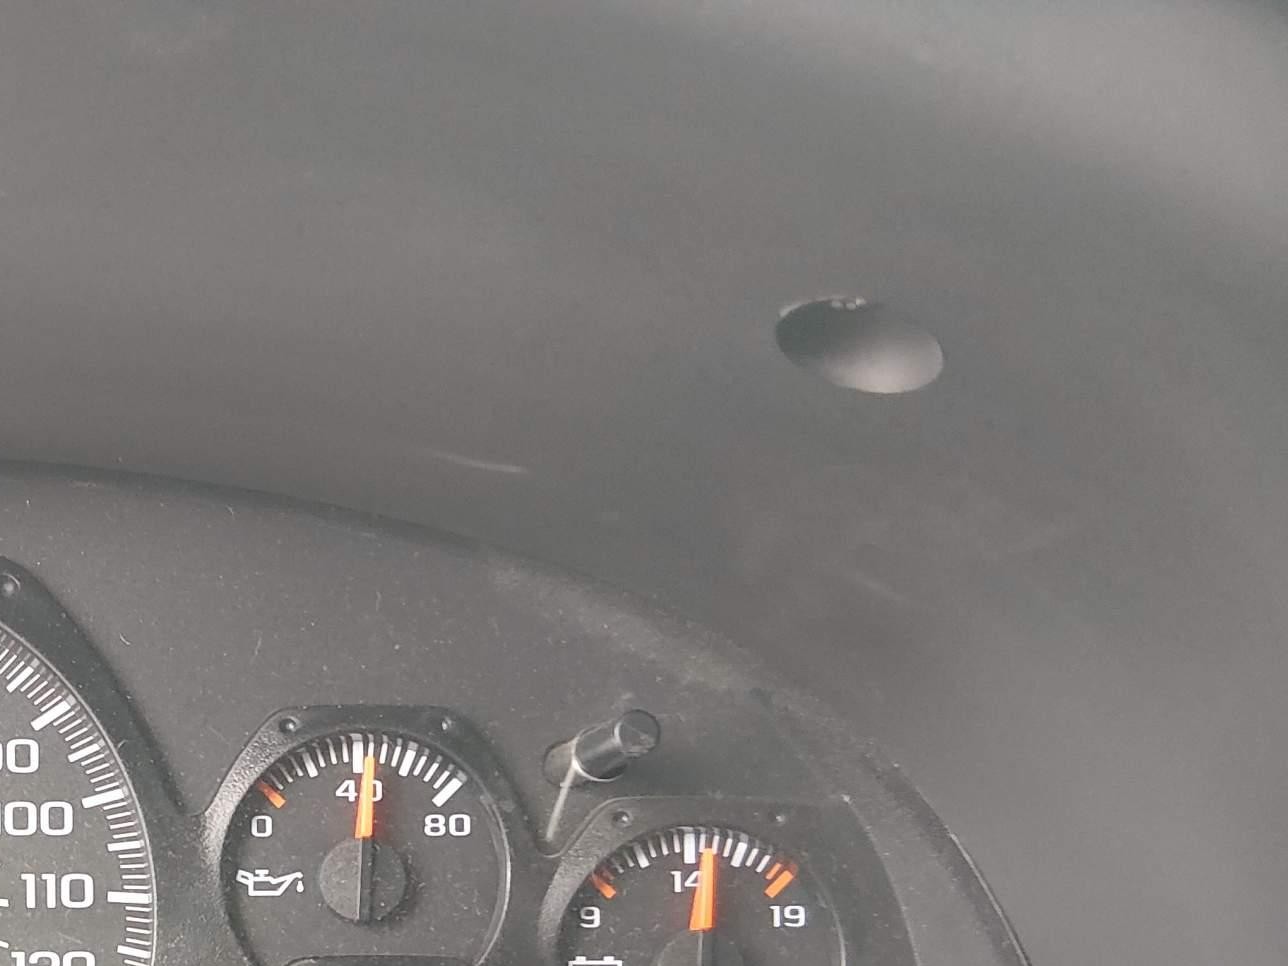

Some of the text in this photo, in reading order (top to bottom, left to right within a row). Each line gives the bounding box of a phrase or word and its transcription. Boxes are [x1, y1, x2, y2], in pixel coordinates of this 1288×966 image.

[251, 815, 273, 838] 0
[424, 813, 471, 837] 80
[20, 873, 94, 909] 110
[580, 906, 601, 928] 9
[769, 905, 806, 928] 19
